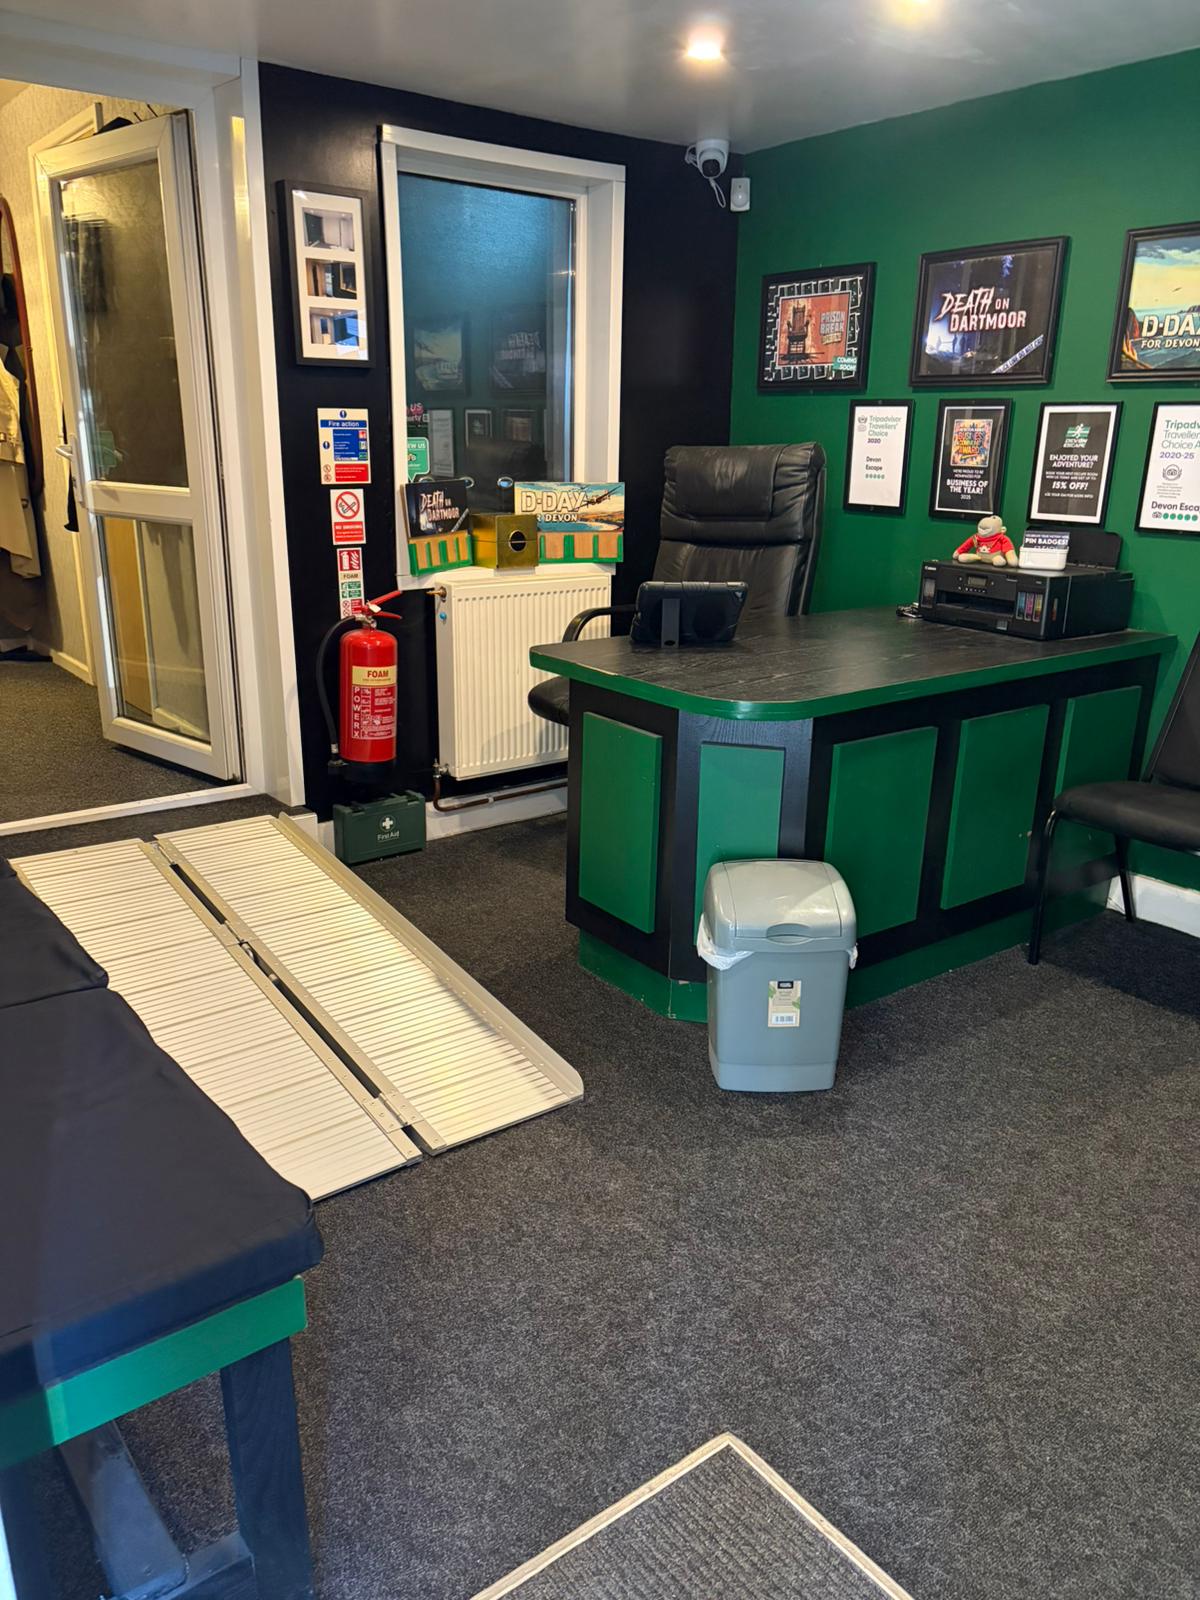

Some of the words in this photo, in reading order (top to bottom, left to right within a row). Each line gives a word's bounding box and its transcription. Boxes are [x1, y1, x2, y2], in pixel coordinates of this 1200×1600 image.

[935, 286, 995, 321] DEATH
[995, 298, 1010, 310] ON
[820, 311, 845, 323] PRISON
[950, 310, 1027, 332] DARTMOOR
[820, 321, 844, 335] BREAK
[1141, 339, 1161, 349] FOR
[1164, 337, 1200, 349] DEVON
[1161, 440, 1193, 449] Choice
[1159, 451, 1195, 459] 2020-25
[1052, 461, 1094, 469] ADVENTURE?
[946, 479, 977, 487] BUSINESS
[977, 480, 989, 488] OF
[1052, 481, 1067, 490] 15%
[1069, 482, 1089, 490] OFF!
[420, 489, 445, 512] DEATH
[1151, 501, 1178, 510] Devon
[1179, 502, 1200, 513] Esca
[427, 506, 460, 522] DARTMOOR
[544, 513, 578, 522] DEVON
[1038, 538, 1069, 546] BADGES!
[367, 670, 389, 678] FOAM
